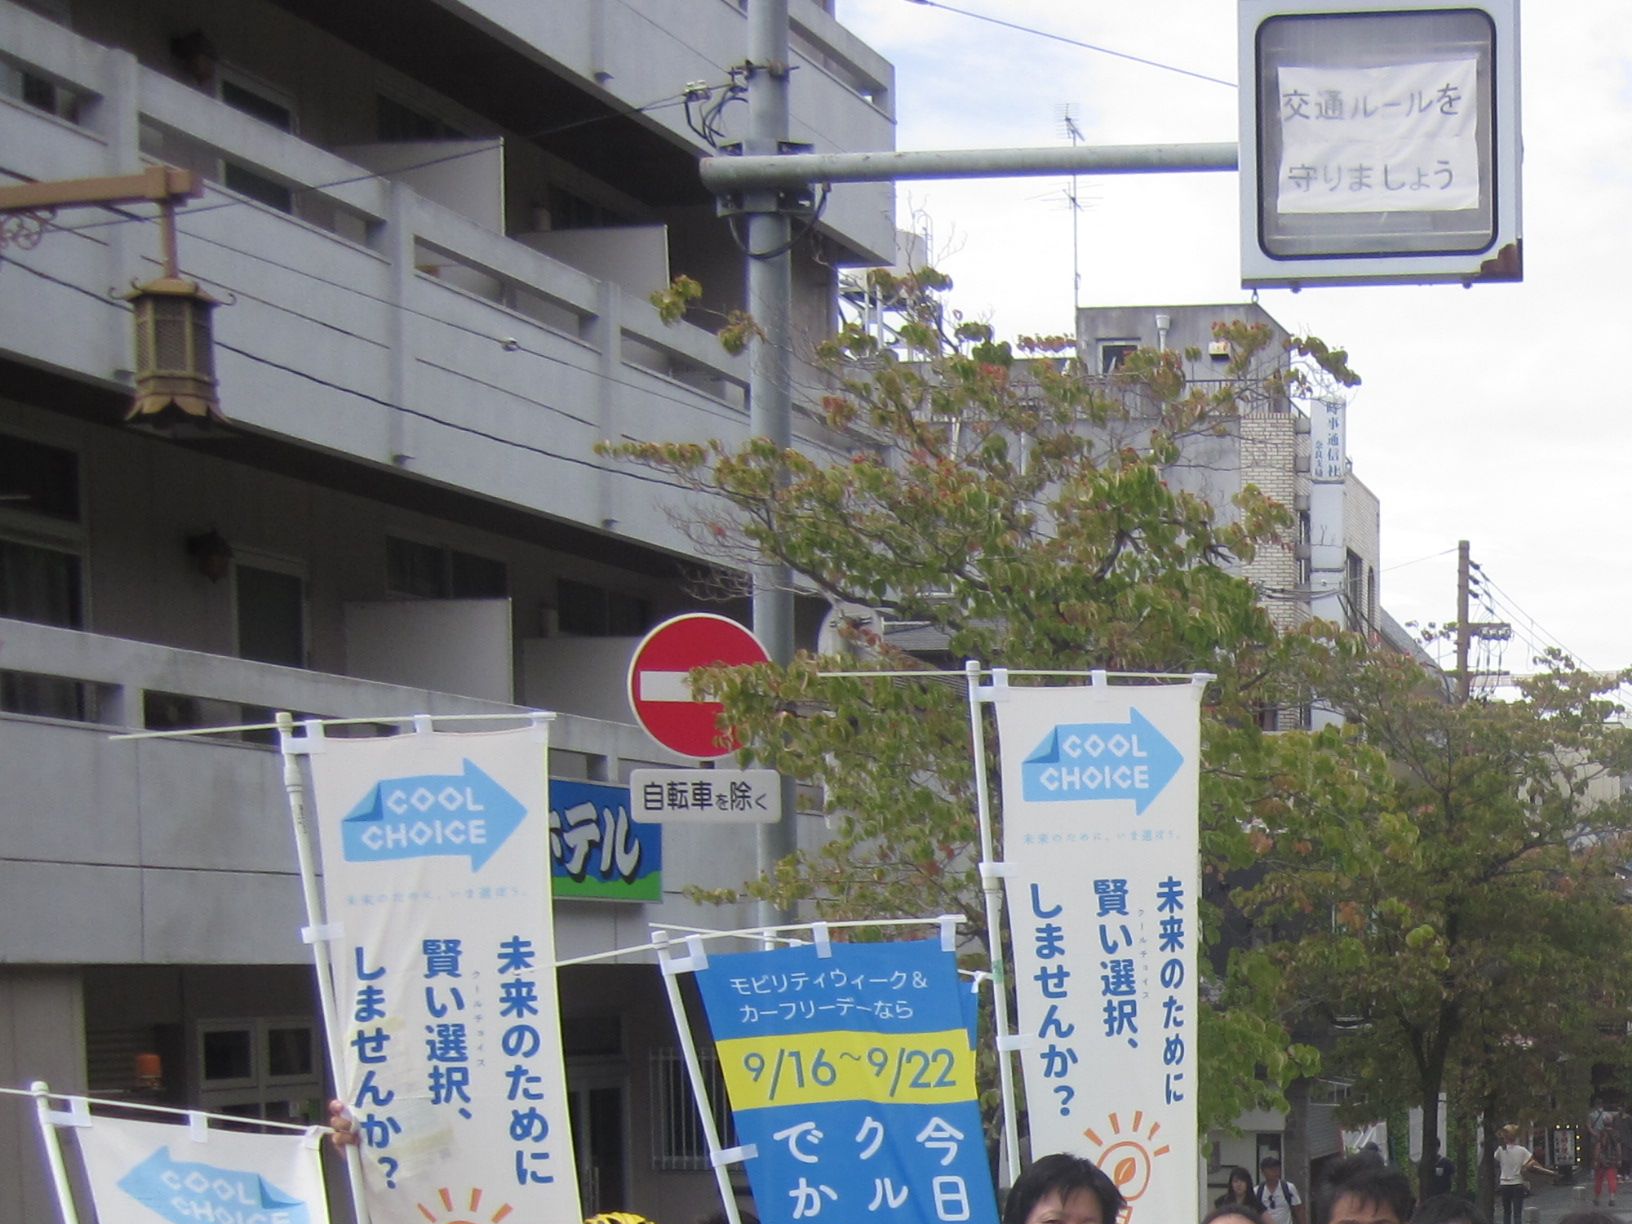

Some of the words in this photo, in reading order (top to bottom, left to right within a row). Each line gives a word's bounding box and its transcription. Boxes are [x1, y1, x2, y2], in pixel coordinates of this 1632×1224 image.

[1281, 83, 1462, 121] 交通ルールを
[1287, 160, 1455, 193] 守りましょう
[1062, 734, 1147, 759] COOL
[1039, 765, 1149, 791] CHOICE
[386, 786, 484, 815] COOL
[643, 780, 767, 812] 自転車を除く
[361, 819, 486, 850] CHOICE
[1093, 879, 1139, 1049] 賢い選択、
[730, 968, 928, 996] モビリティウィーク&
[1156, 876, 1185, 1105] 未来のために
[740, 997, 914, 1024] カーフリーデーなら
[1030, 883, 1079, 1117] しませんか？
[423, 939, 473, 1120] 賢い選択、
[351, 946, 402, 1189] しませんか？
[497, 936, 554, 1185] 未来のために
[160, 1169, 257, 1206] COOL
